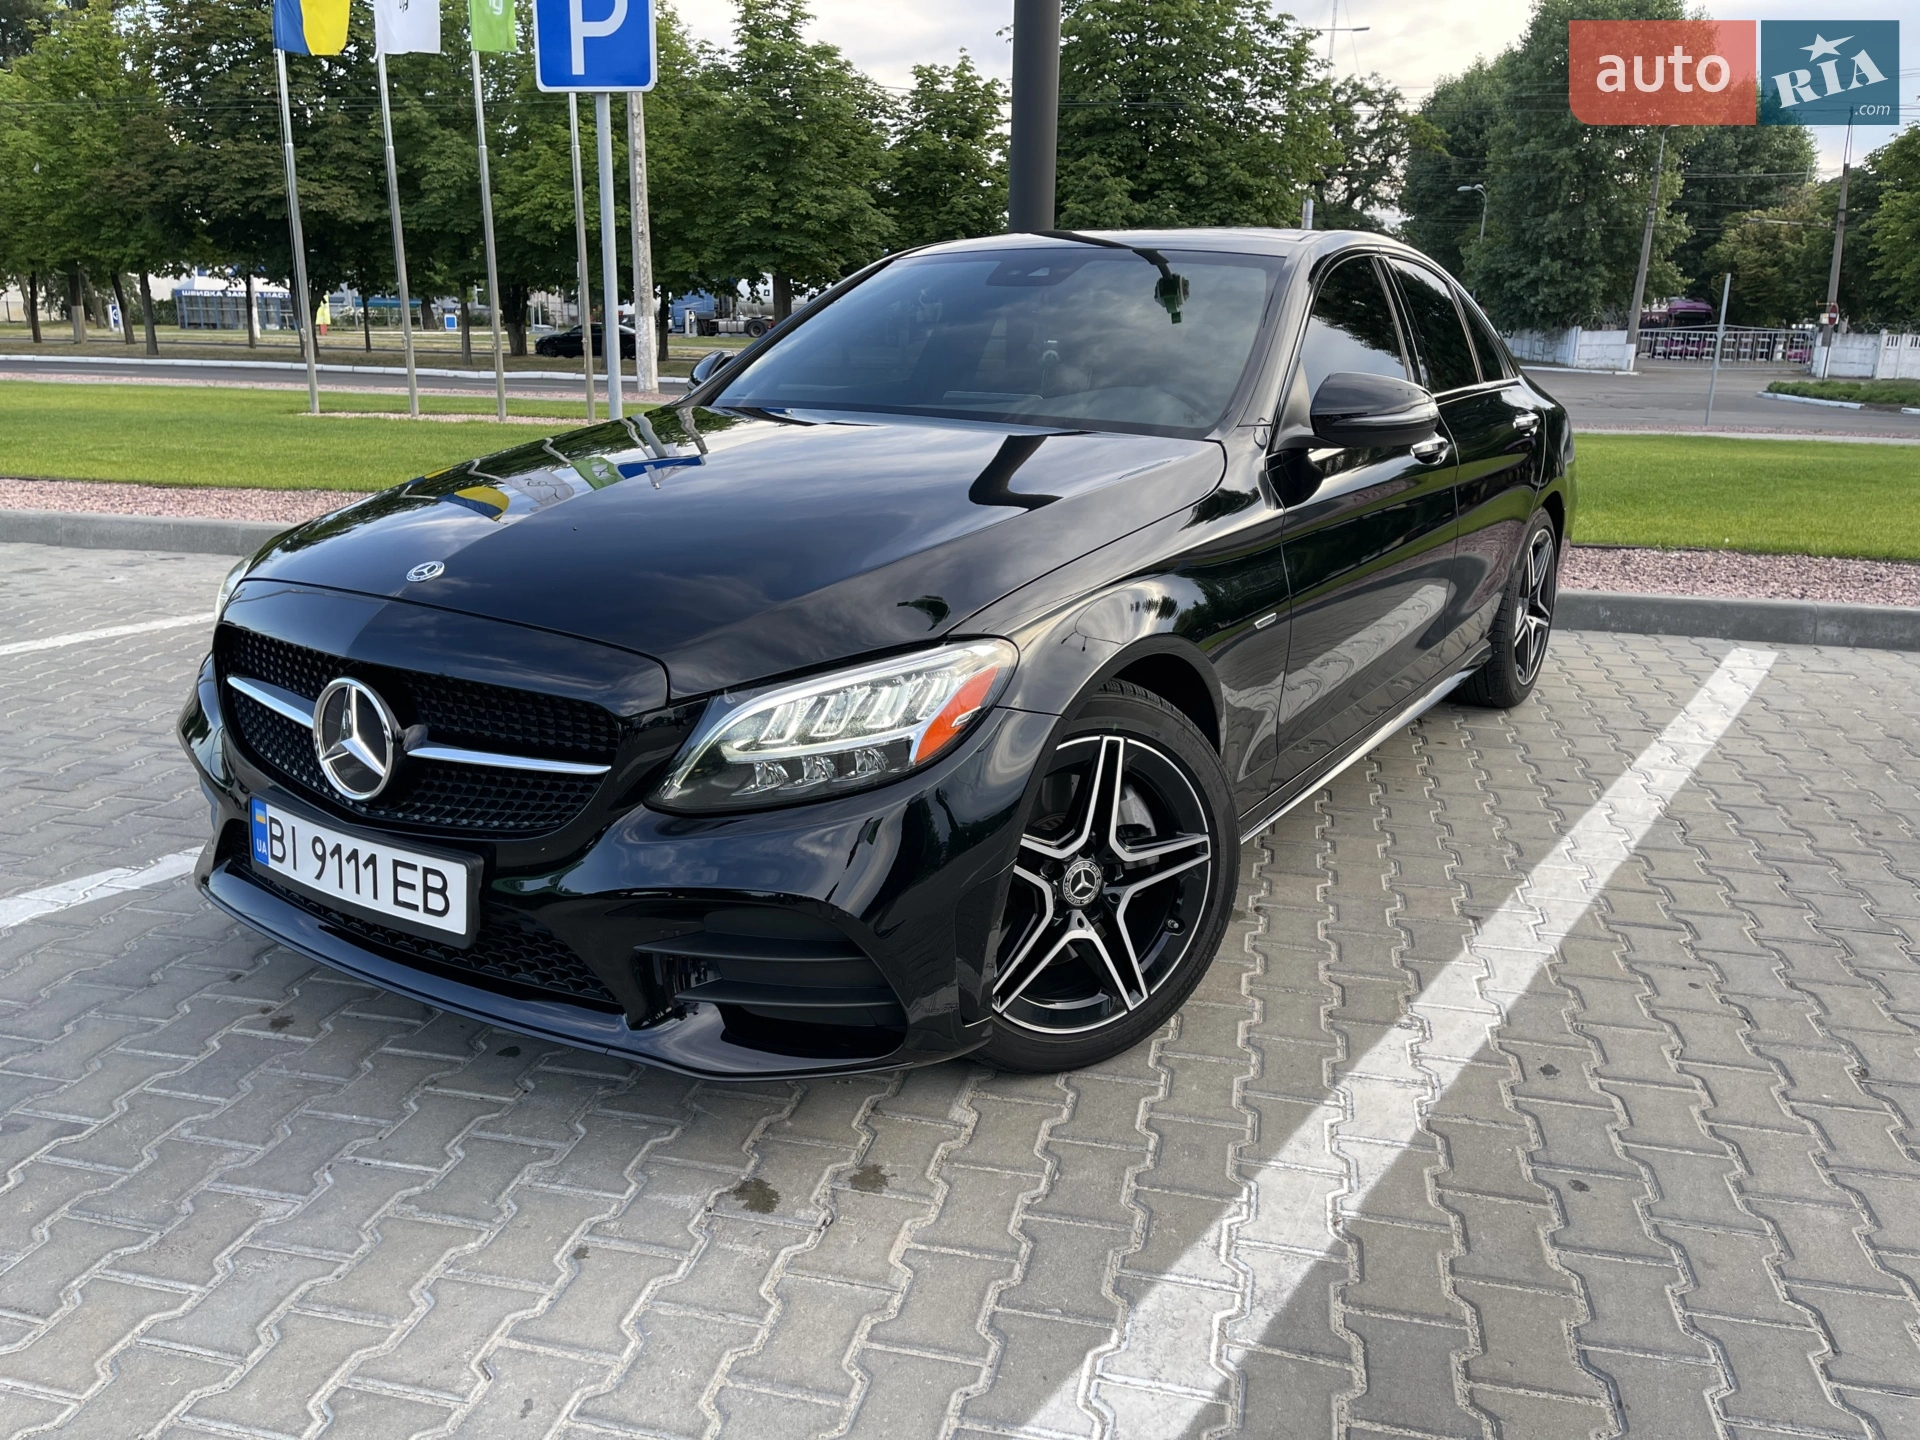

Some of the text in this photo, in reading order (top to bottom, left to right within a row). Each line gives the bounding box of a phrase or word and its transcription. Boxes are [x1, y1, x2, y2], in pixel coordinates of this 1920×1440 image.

[569, 0, 628, 75] P
[256, 839, 268, 856] UA
[269, 815, 450, 918] BI 9111 EB
